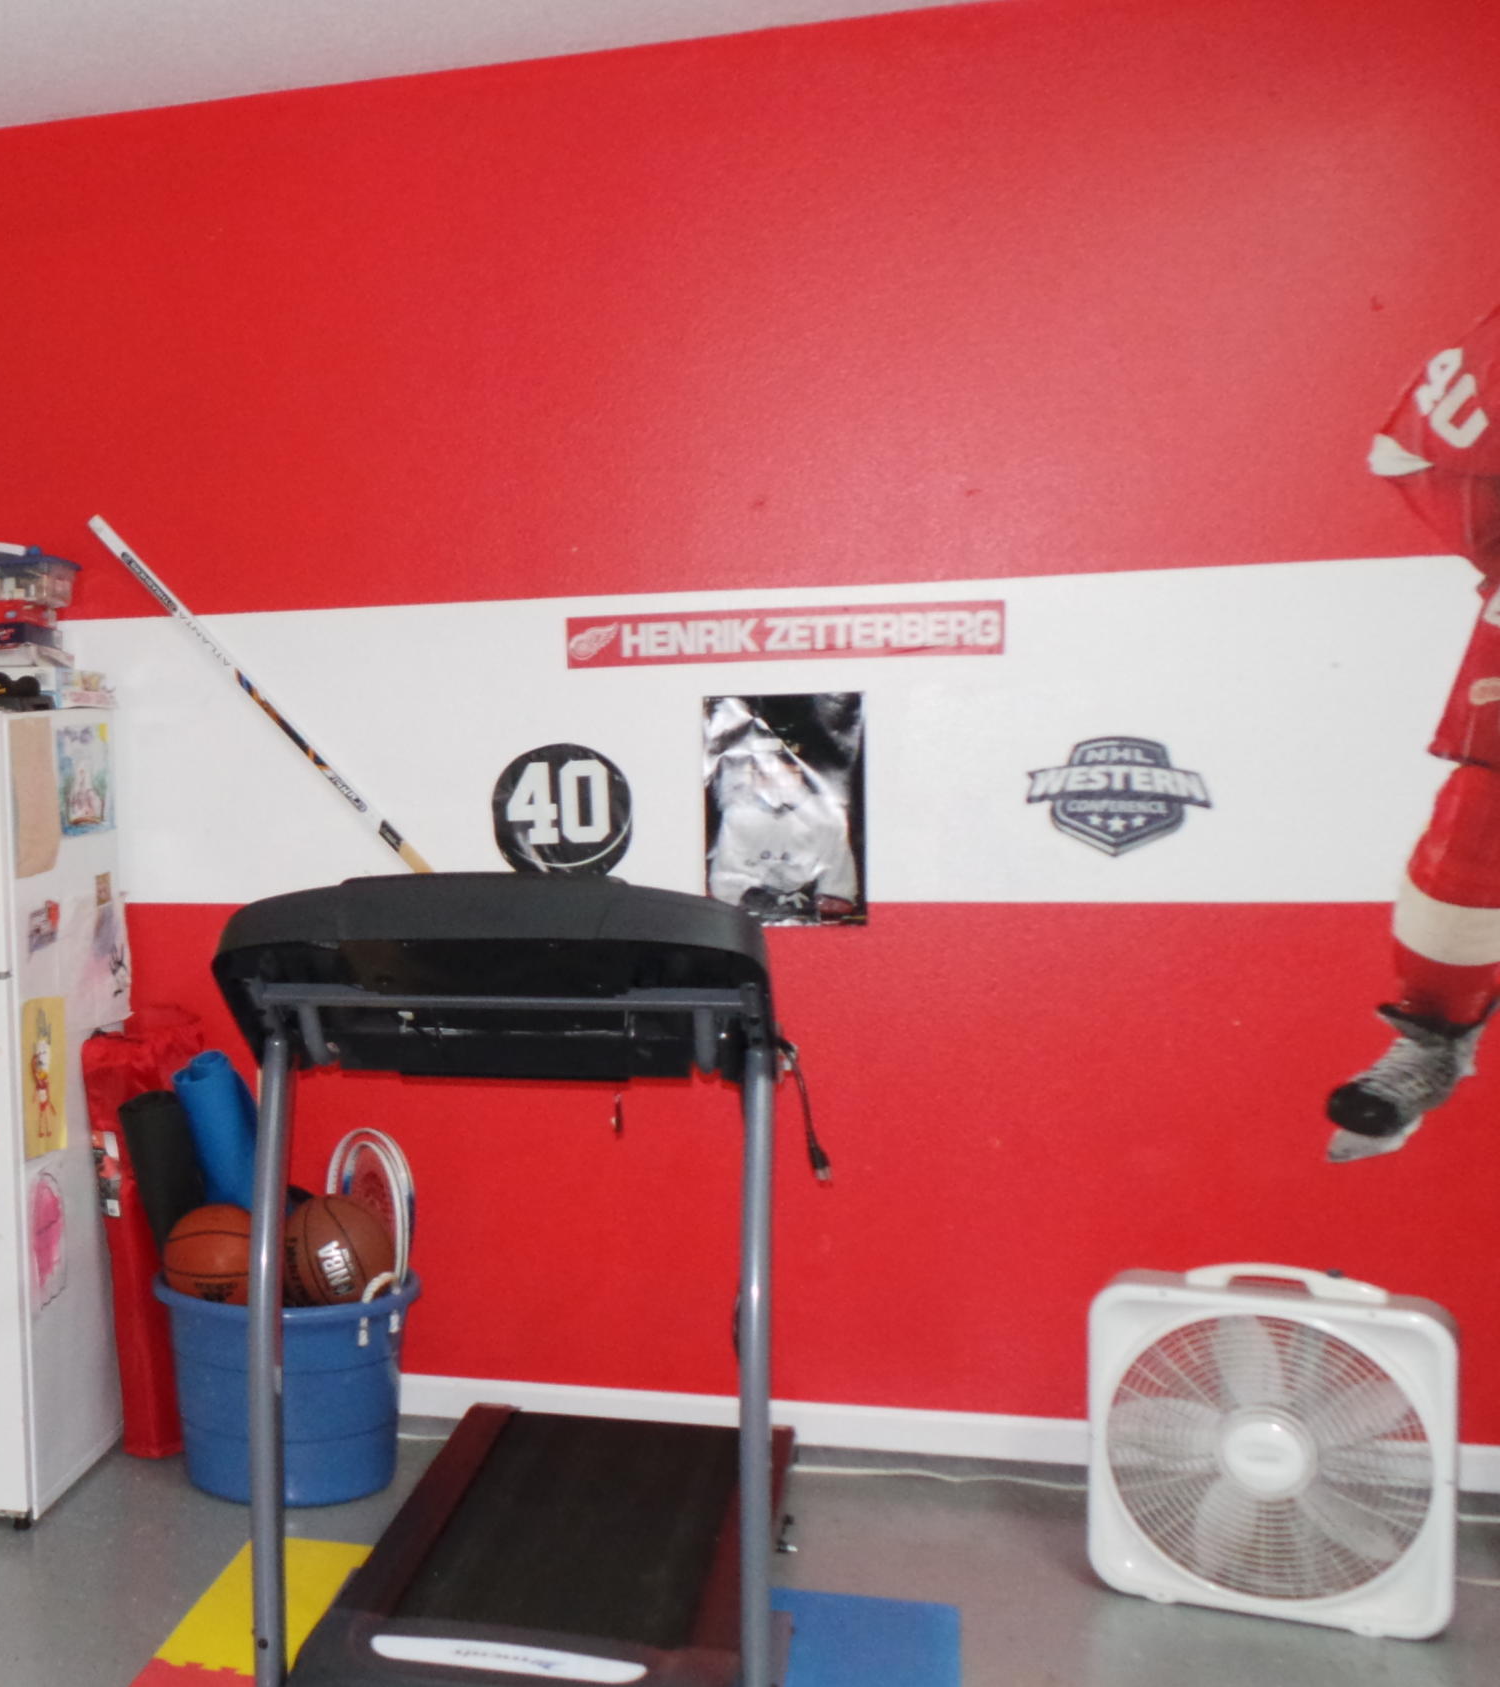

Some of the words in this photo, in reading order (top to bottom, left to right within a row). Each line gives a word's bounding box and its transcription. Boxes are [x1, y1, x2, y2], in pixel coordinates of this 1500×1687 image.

[620, 617, 761, 658] HENRIK
[763, 609, 1000, 653] ZETTERBERG
[1084, 748, 1155, 764] NHL
[506, 758, 612, 845] 40
[1030, 765, 1209, 801] WESTERN
[1066, 801, 1168, 815] CONFERENCE
[317, 1241, 351, 1287] NBA
